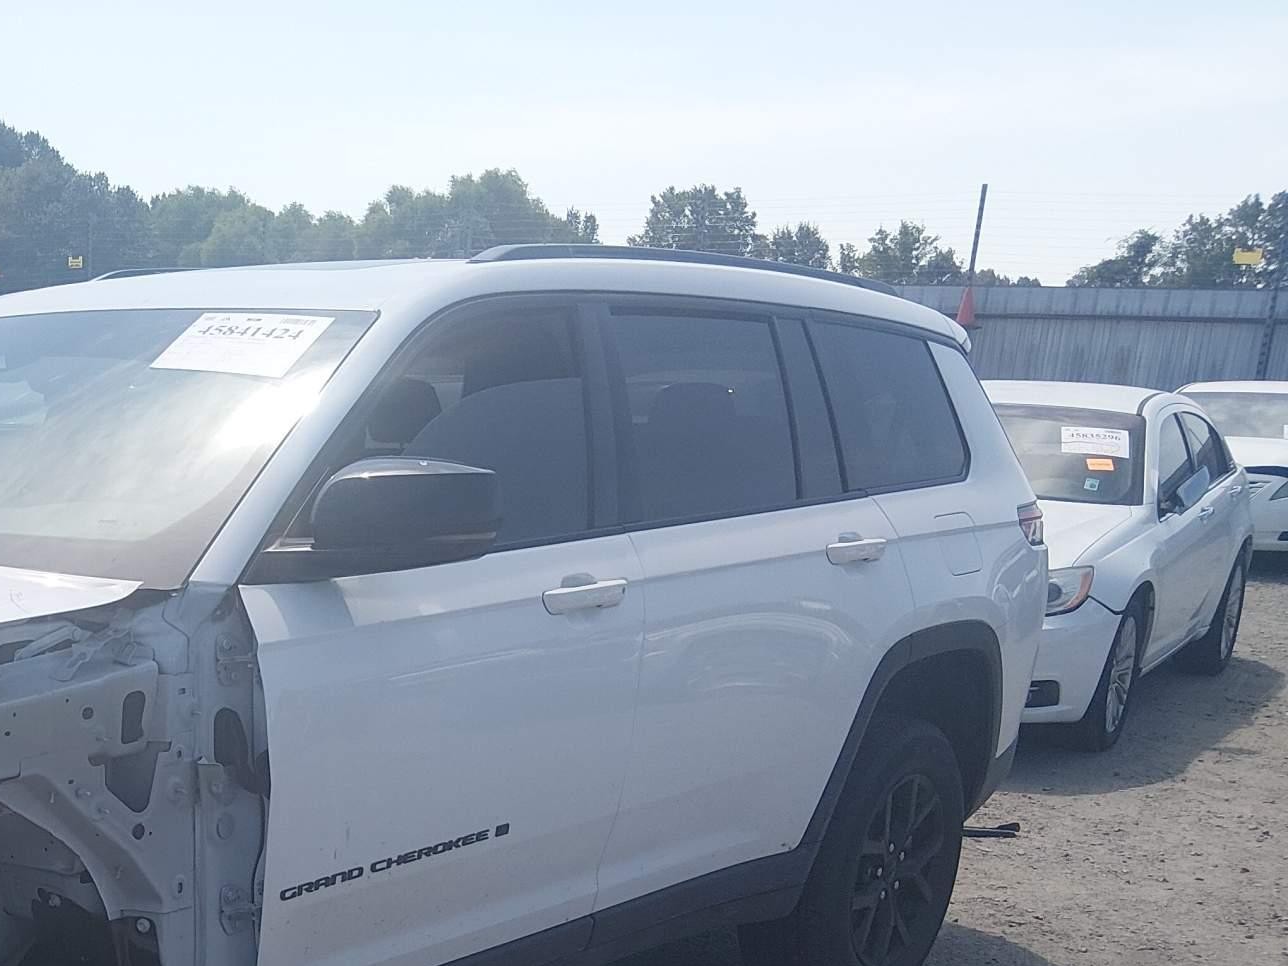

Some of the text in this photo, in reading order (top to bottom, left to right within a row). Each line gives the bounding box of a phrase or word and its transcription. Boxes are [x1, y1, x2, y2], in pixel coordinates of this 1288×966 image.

[198, 325, 304, 340] 45841424
[279, 828, 490, 901] GRAND CHEROKEE
